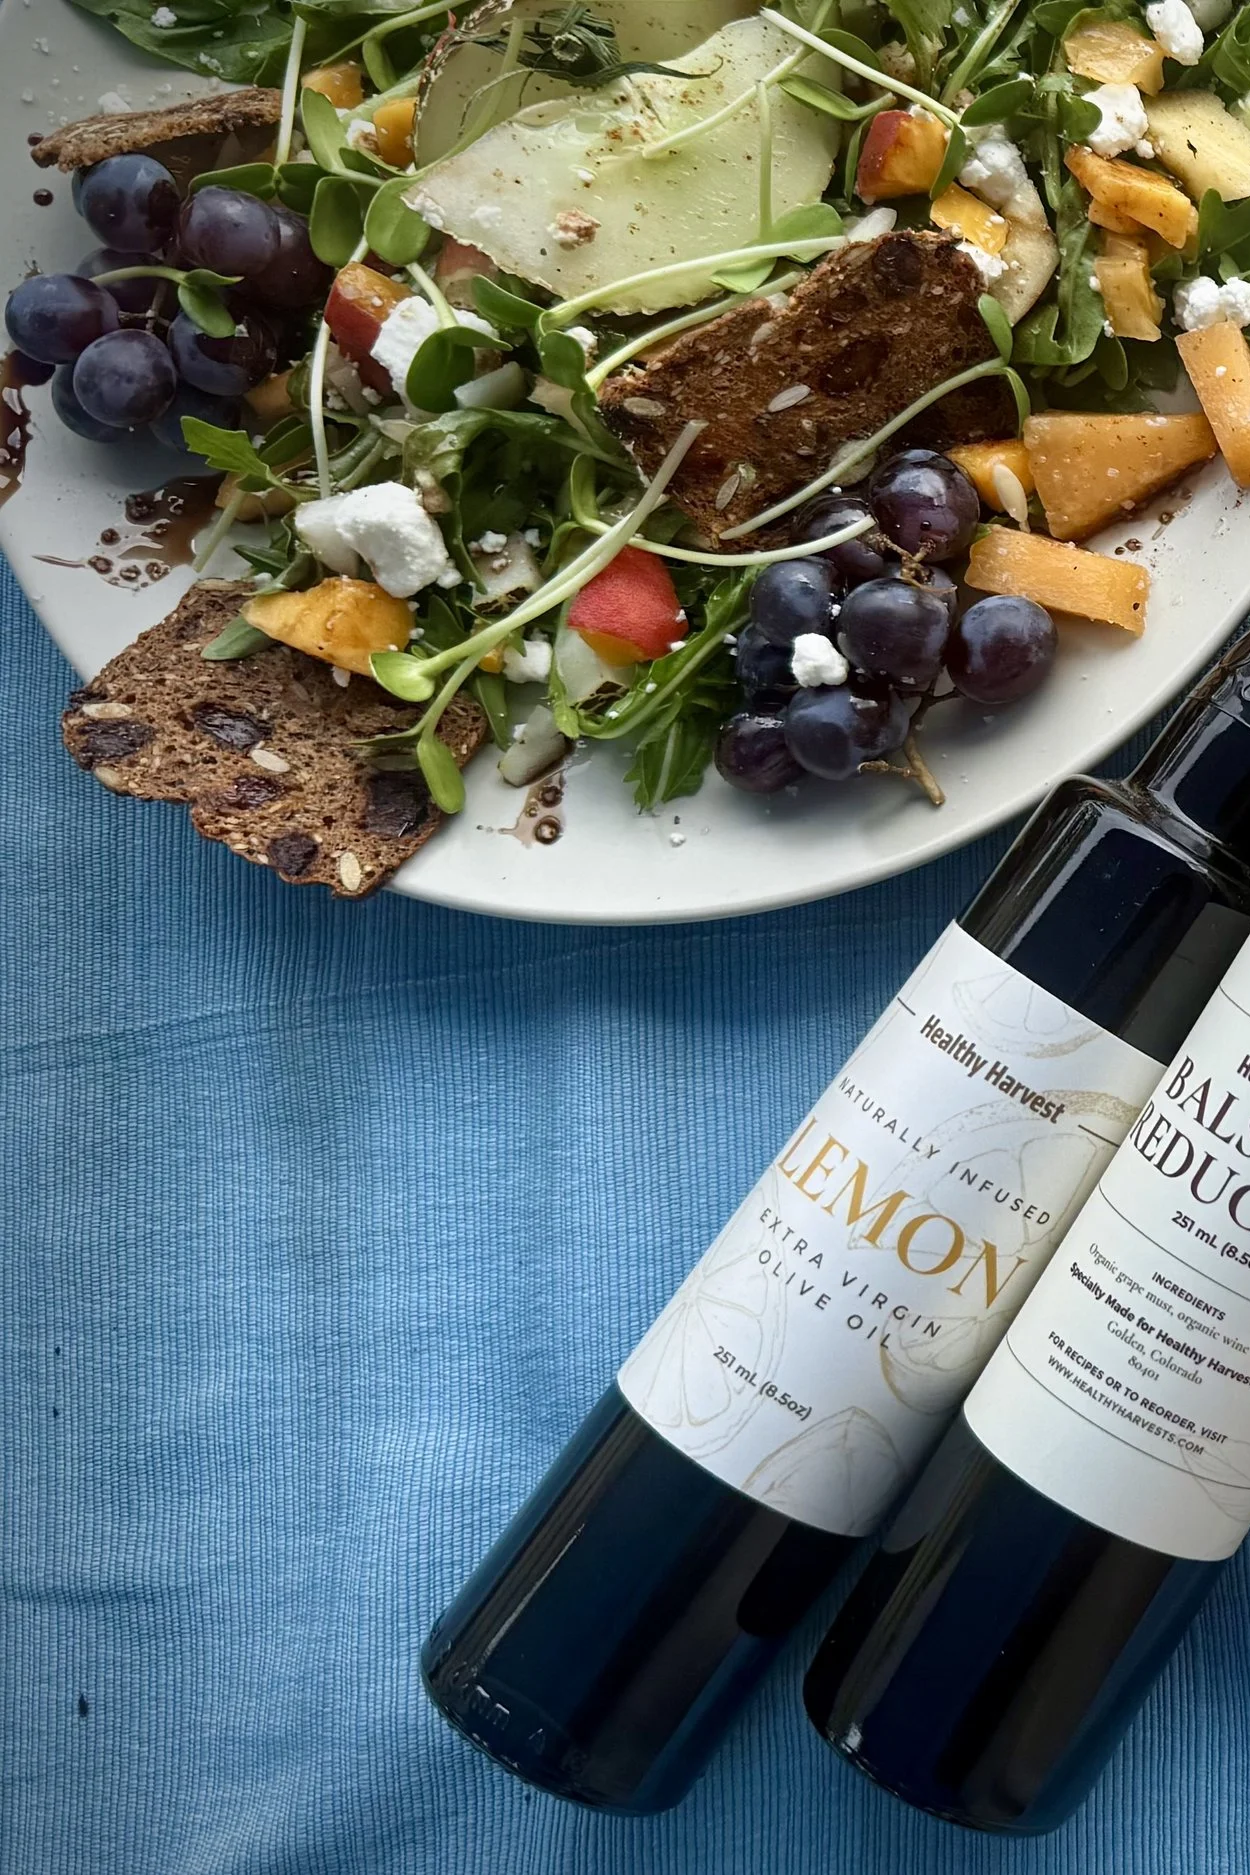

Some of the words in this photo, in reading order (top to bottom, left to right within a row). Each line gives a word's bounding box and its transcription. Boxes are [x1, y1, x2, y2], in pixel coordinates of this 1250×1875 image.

[919, 1014, 989, 1078] Healthy
[983, 1060, 1066, 1124] Harvest
[838, 1076, 941, 1160] NATURALLY
[948, 1161, 1051, 1225] INFUSED
[778, 1117, 1026, 1310] LEMON
[1171, 1210, 1196, 1233] 251
[1194, 1227, 1218, 1249] mL
[758, 1249, 832, 1311] OLIVE
[846, 1314, 891, 1351] OIL
[759, 1207, 824, 1270] EXTRA
[841, 1270, 942, 1338] VIRGIN
[1070, 1261, 1106, 1301] Specialty
[1104, 1294, 1136, 1322] Made
[1135, 1316, 1156, 1335] for
[1155, 1328, 1207, 1366] Healthy
[1087, 1241, 1119, 1275] Organic
[1114, 1271, 1145, 1295] grape
[1145, 1291, 1174, 1317] must,
[1176, 1311, 1221, 1340] organic
[1222, 1335, 1250, 1355] wine
[1151, 1271, 1226, 1321] INGREDIENTS
[712, 1345, 737, 1369] 251
[734, 1364, 758, 1388] mL
[758, 1380, 813, 1422] (8.5oz)
[1048, 1330, 1066, 1351] FOR
[1063, 1345, 1105, 1381] RECIPES
[1105, 1376, 1123, 1393] OR
[1123, 1386, 1140, 1402] TO
[1139, 1397, 1196, 1434] REORDER,
[1200, 1426, 1229, 1444] VISIT
[1106, 1320, 1146, 1356] Golden,
[1149, 1349, 1203, 1385] Colorado
[1127, 1355, 1160, 1382] 80401
[1047, 1354, 1205, 1455] WWW.HEALTHYHARVESTS.COM
